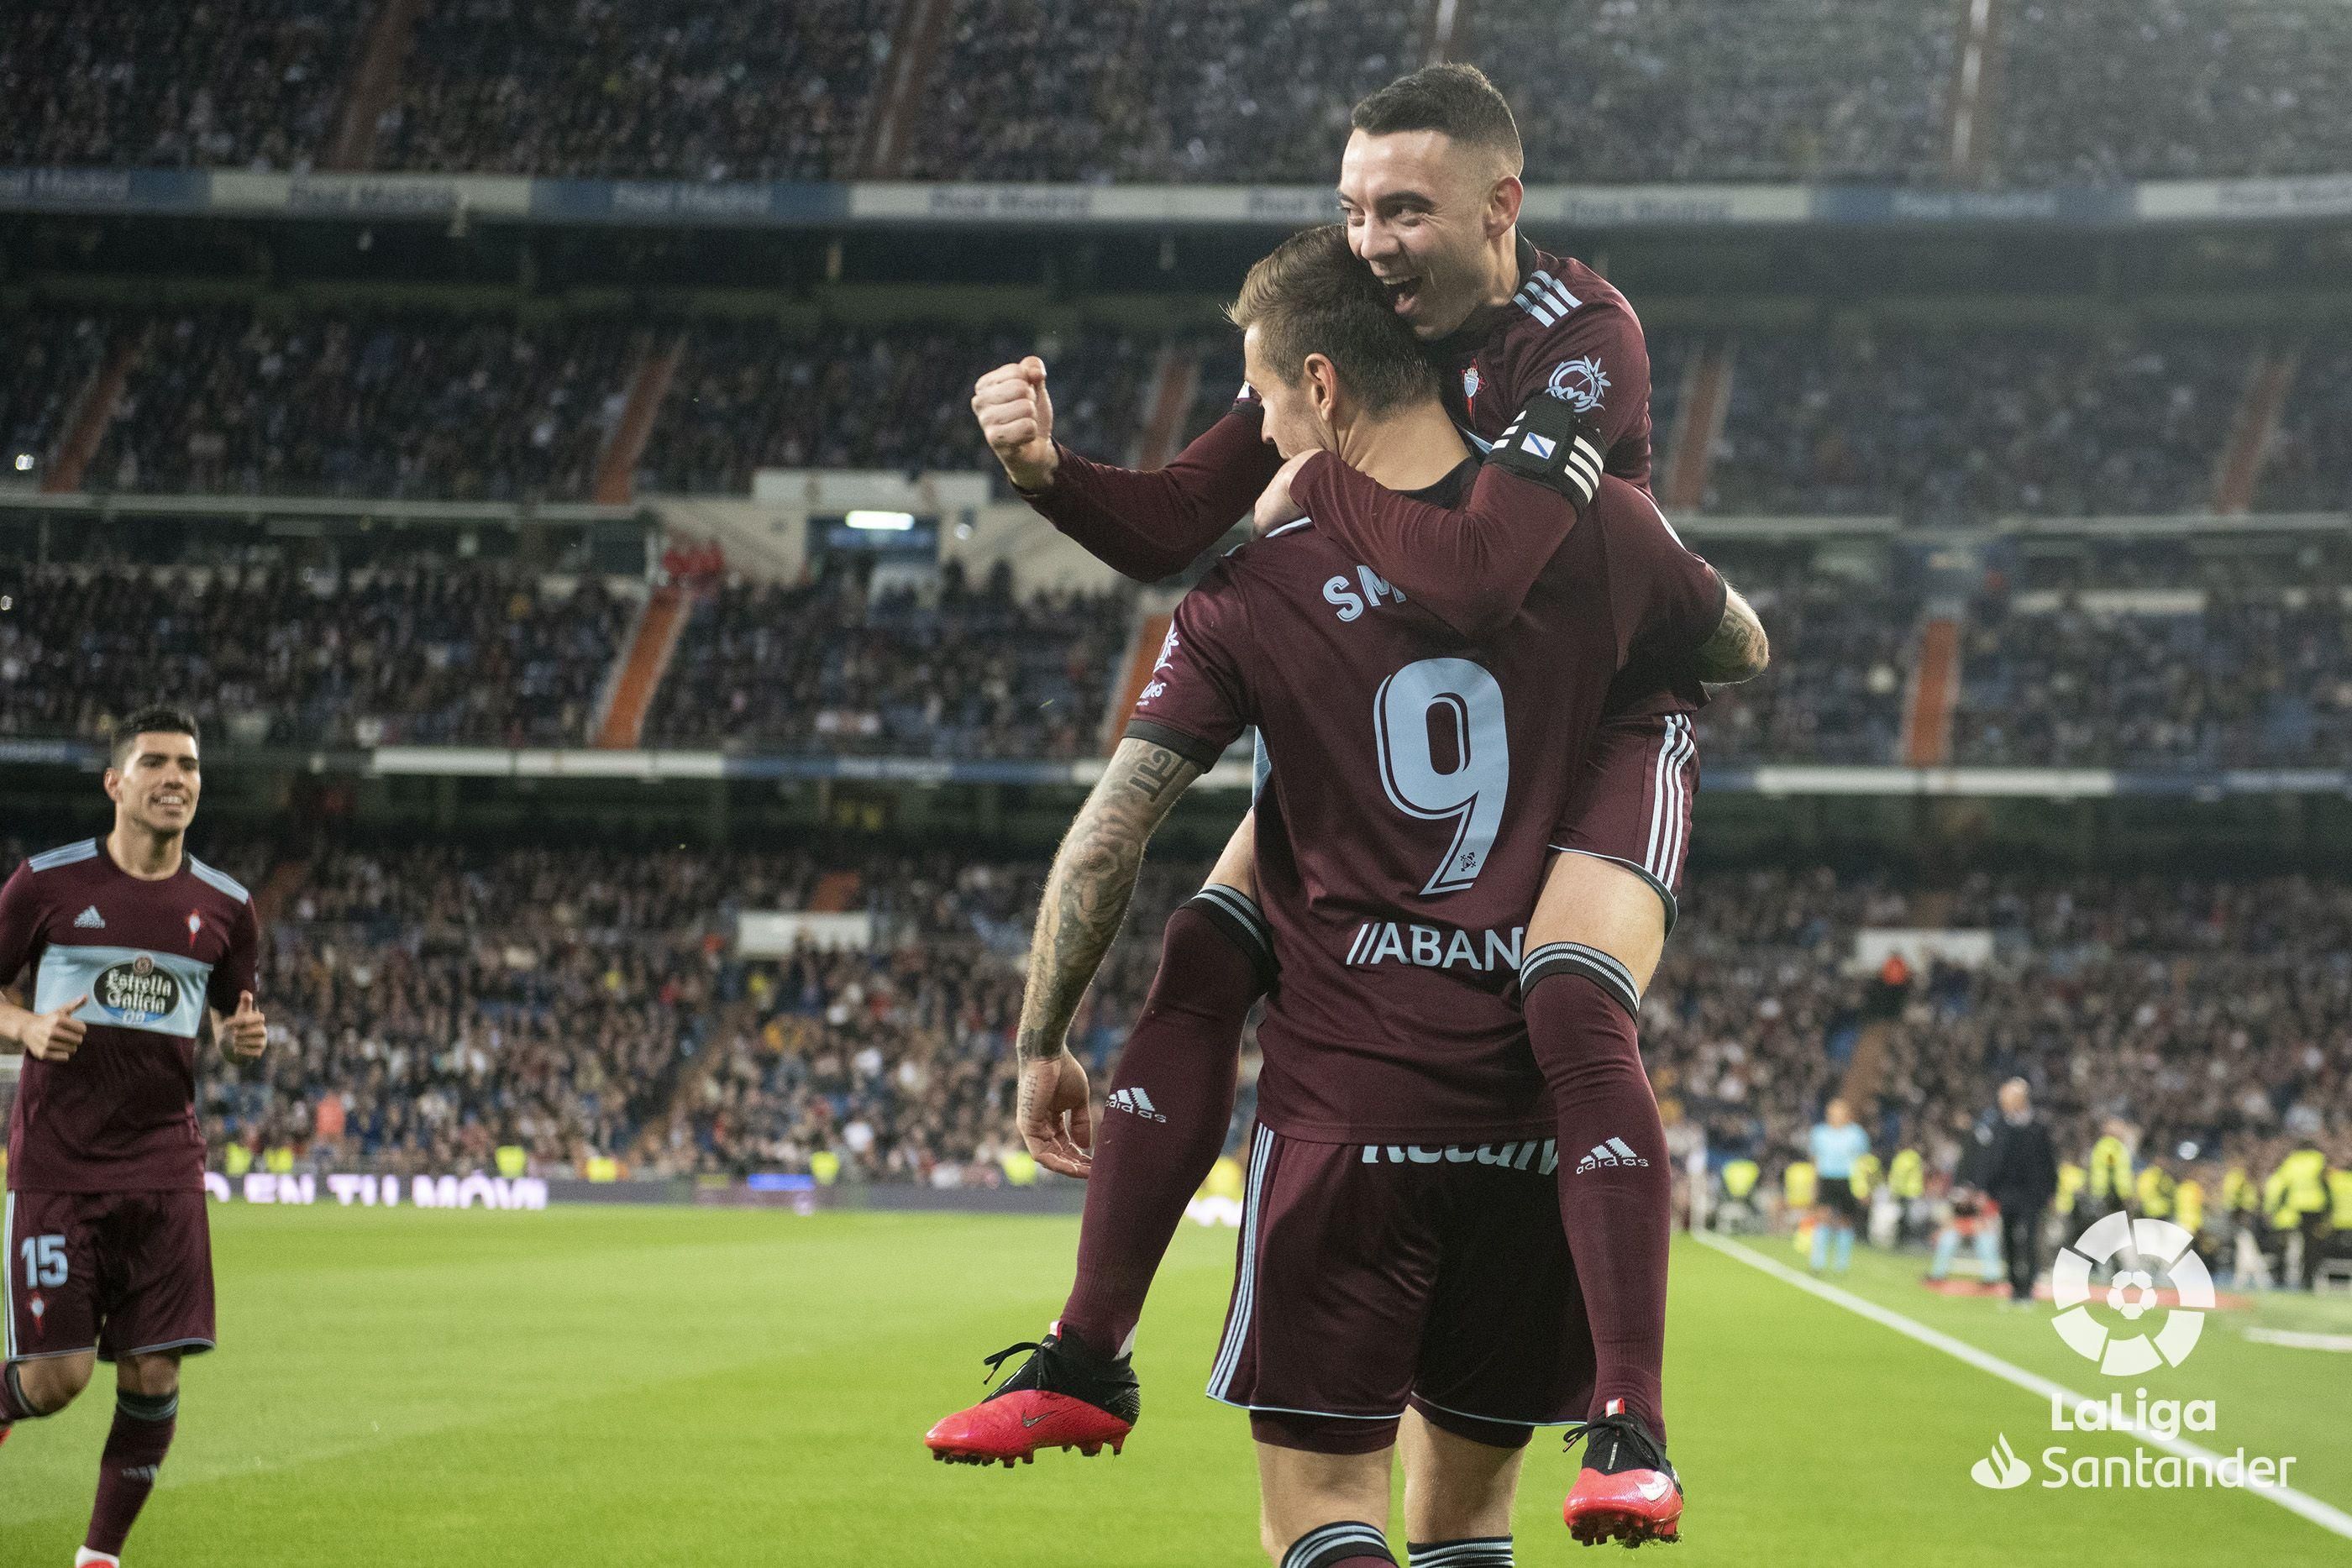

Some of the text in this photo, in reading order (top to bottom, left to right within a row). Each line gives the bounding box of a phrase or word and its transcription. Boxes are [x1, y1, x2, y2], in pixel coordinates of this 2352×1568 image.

[1373, 658, 1509, 895] 9
[106, 968, 171, 999] Estrella
[107, 990, 166, 1015] Galicia
[1576, 1156, 1649, 1175] adidas
[244, 1173, 315, 1204] EN
[21, 1234, 68, 1289] 15
